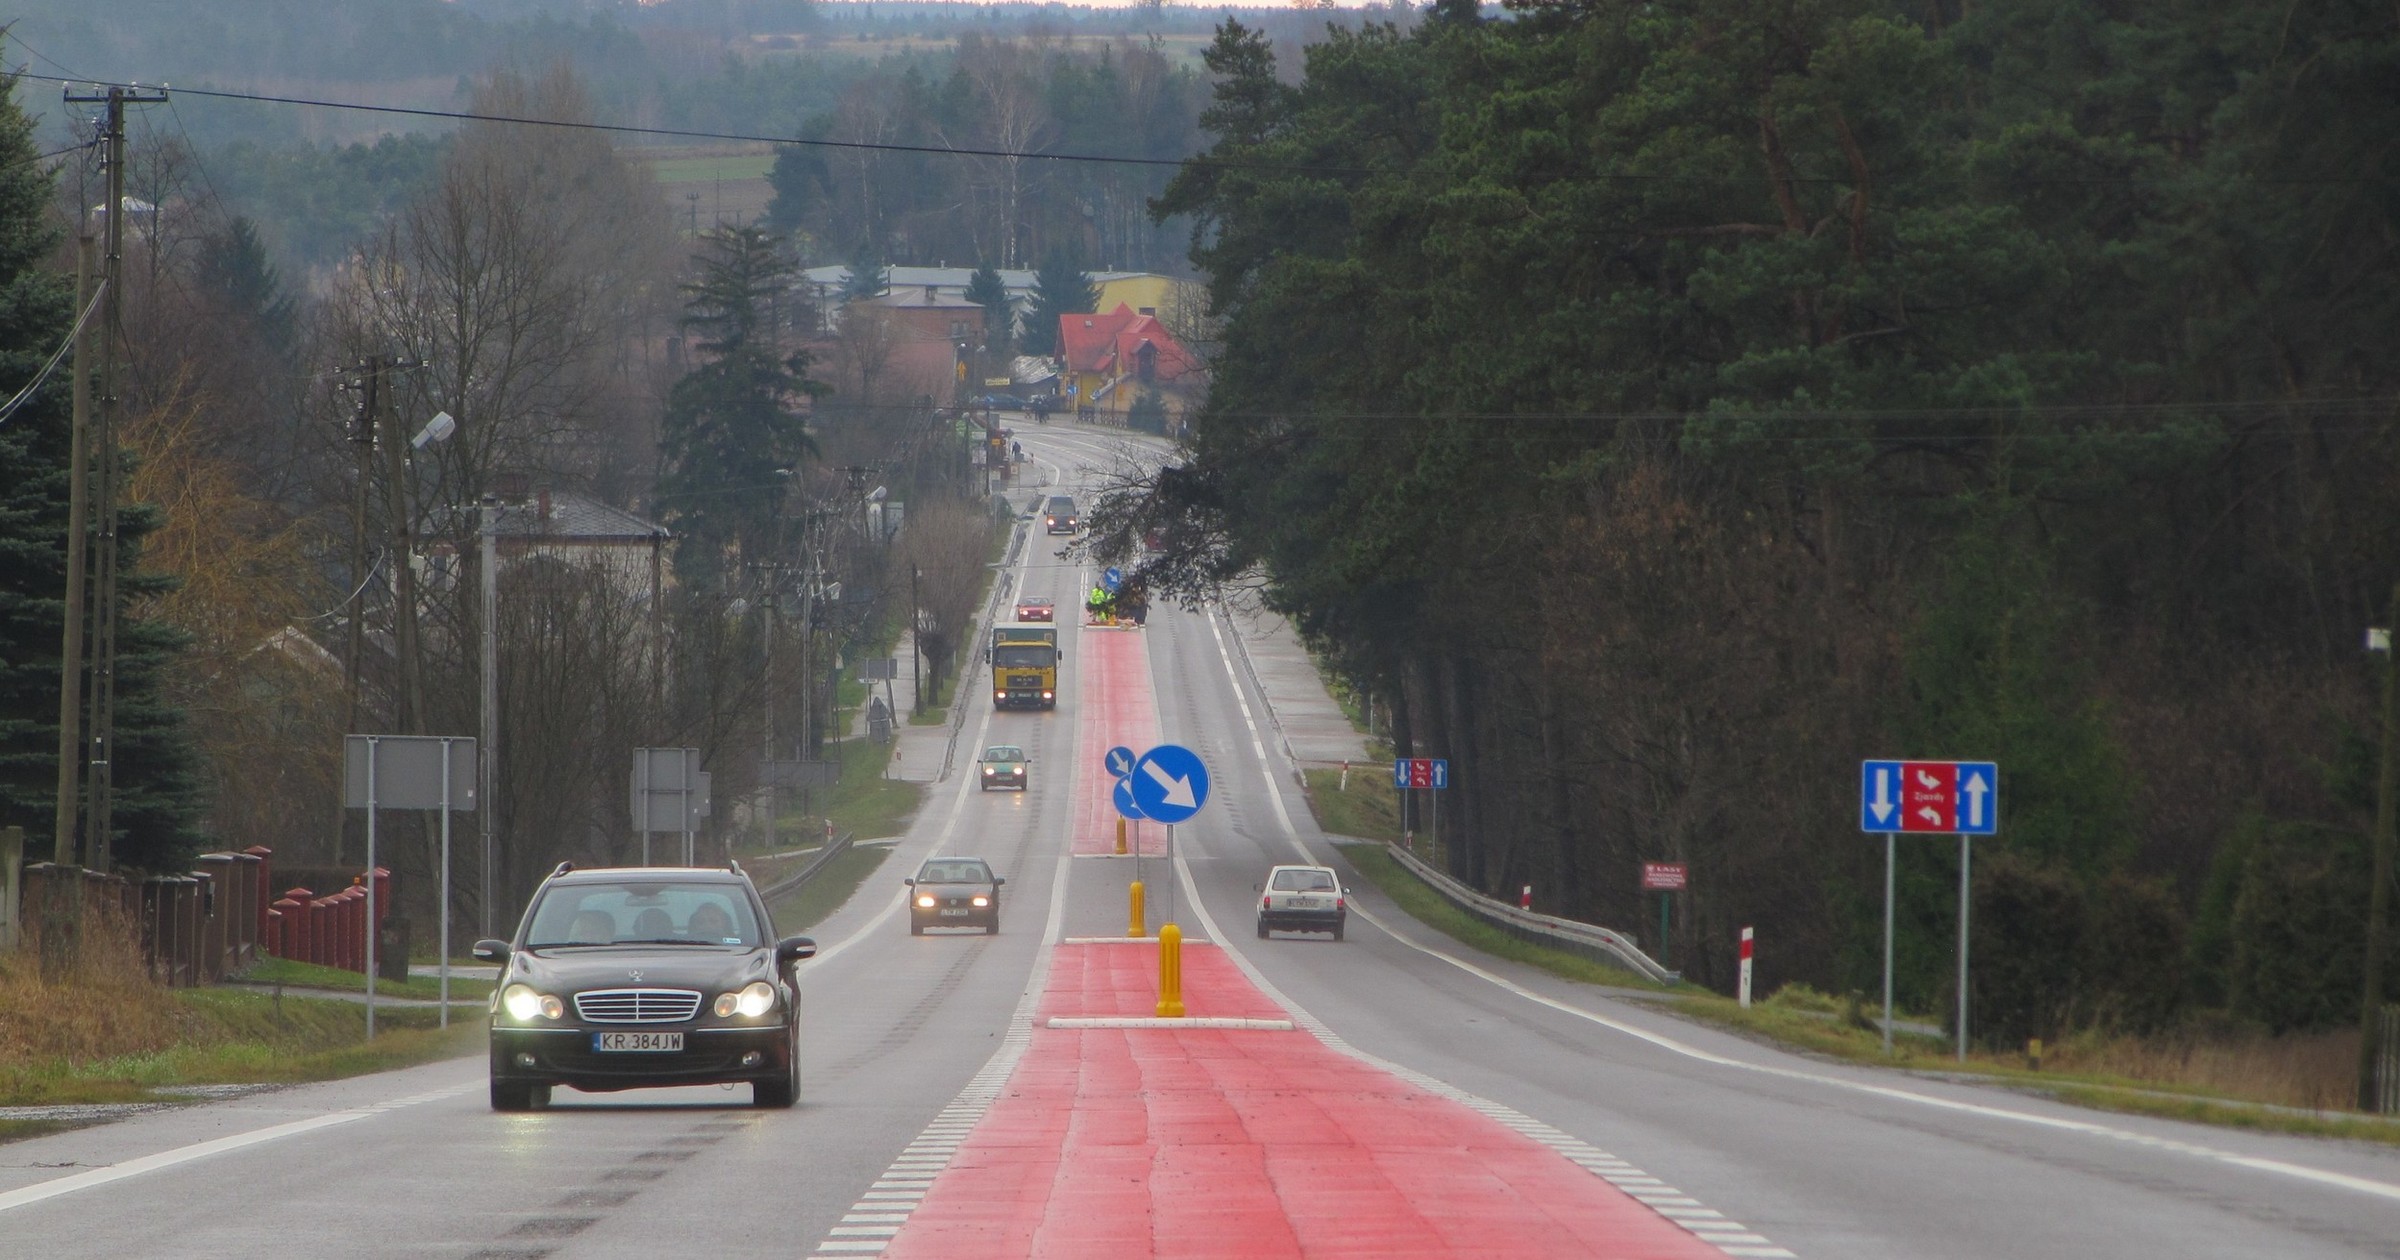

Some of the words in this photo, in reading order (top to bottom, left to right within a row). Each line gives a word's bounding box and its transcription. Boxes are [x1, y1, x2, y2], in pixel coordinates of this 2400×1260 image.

[1914, 792, 1944, 802] Zjazdy
[603, 1035, 625, 1049] KR
[632, 1034, 681, 1049] 384JW
